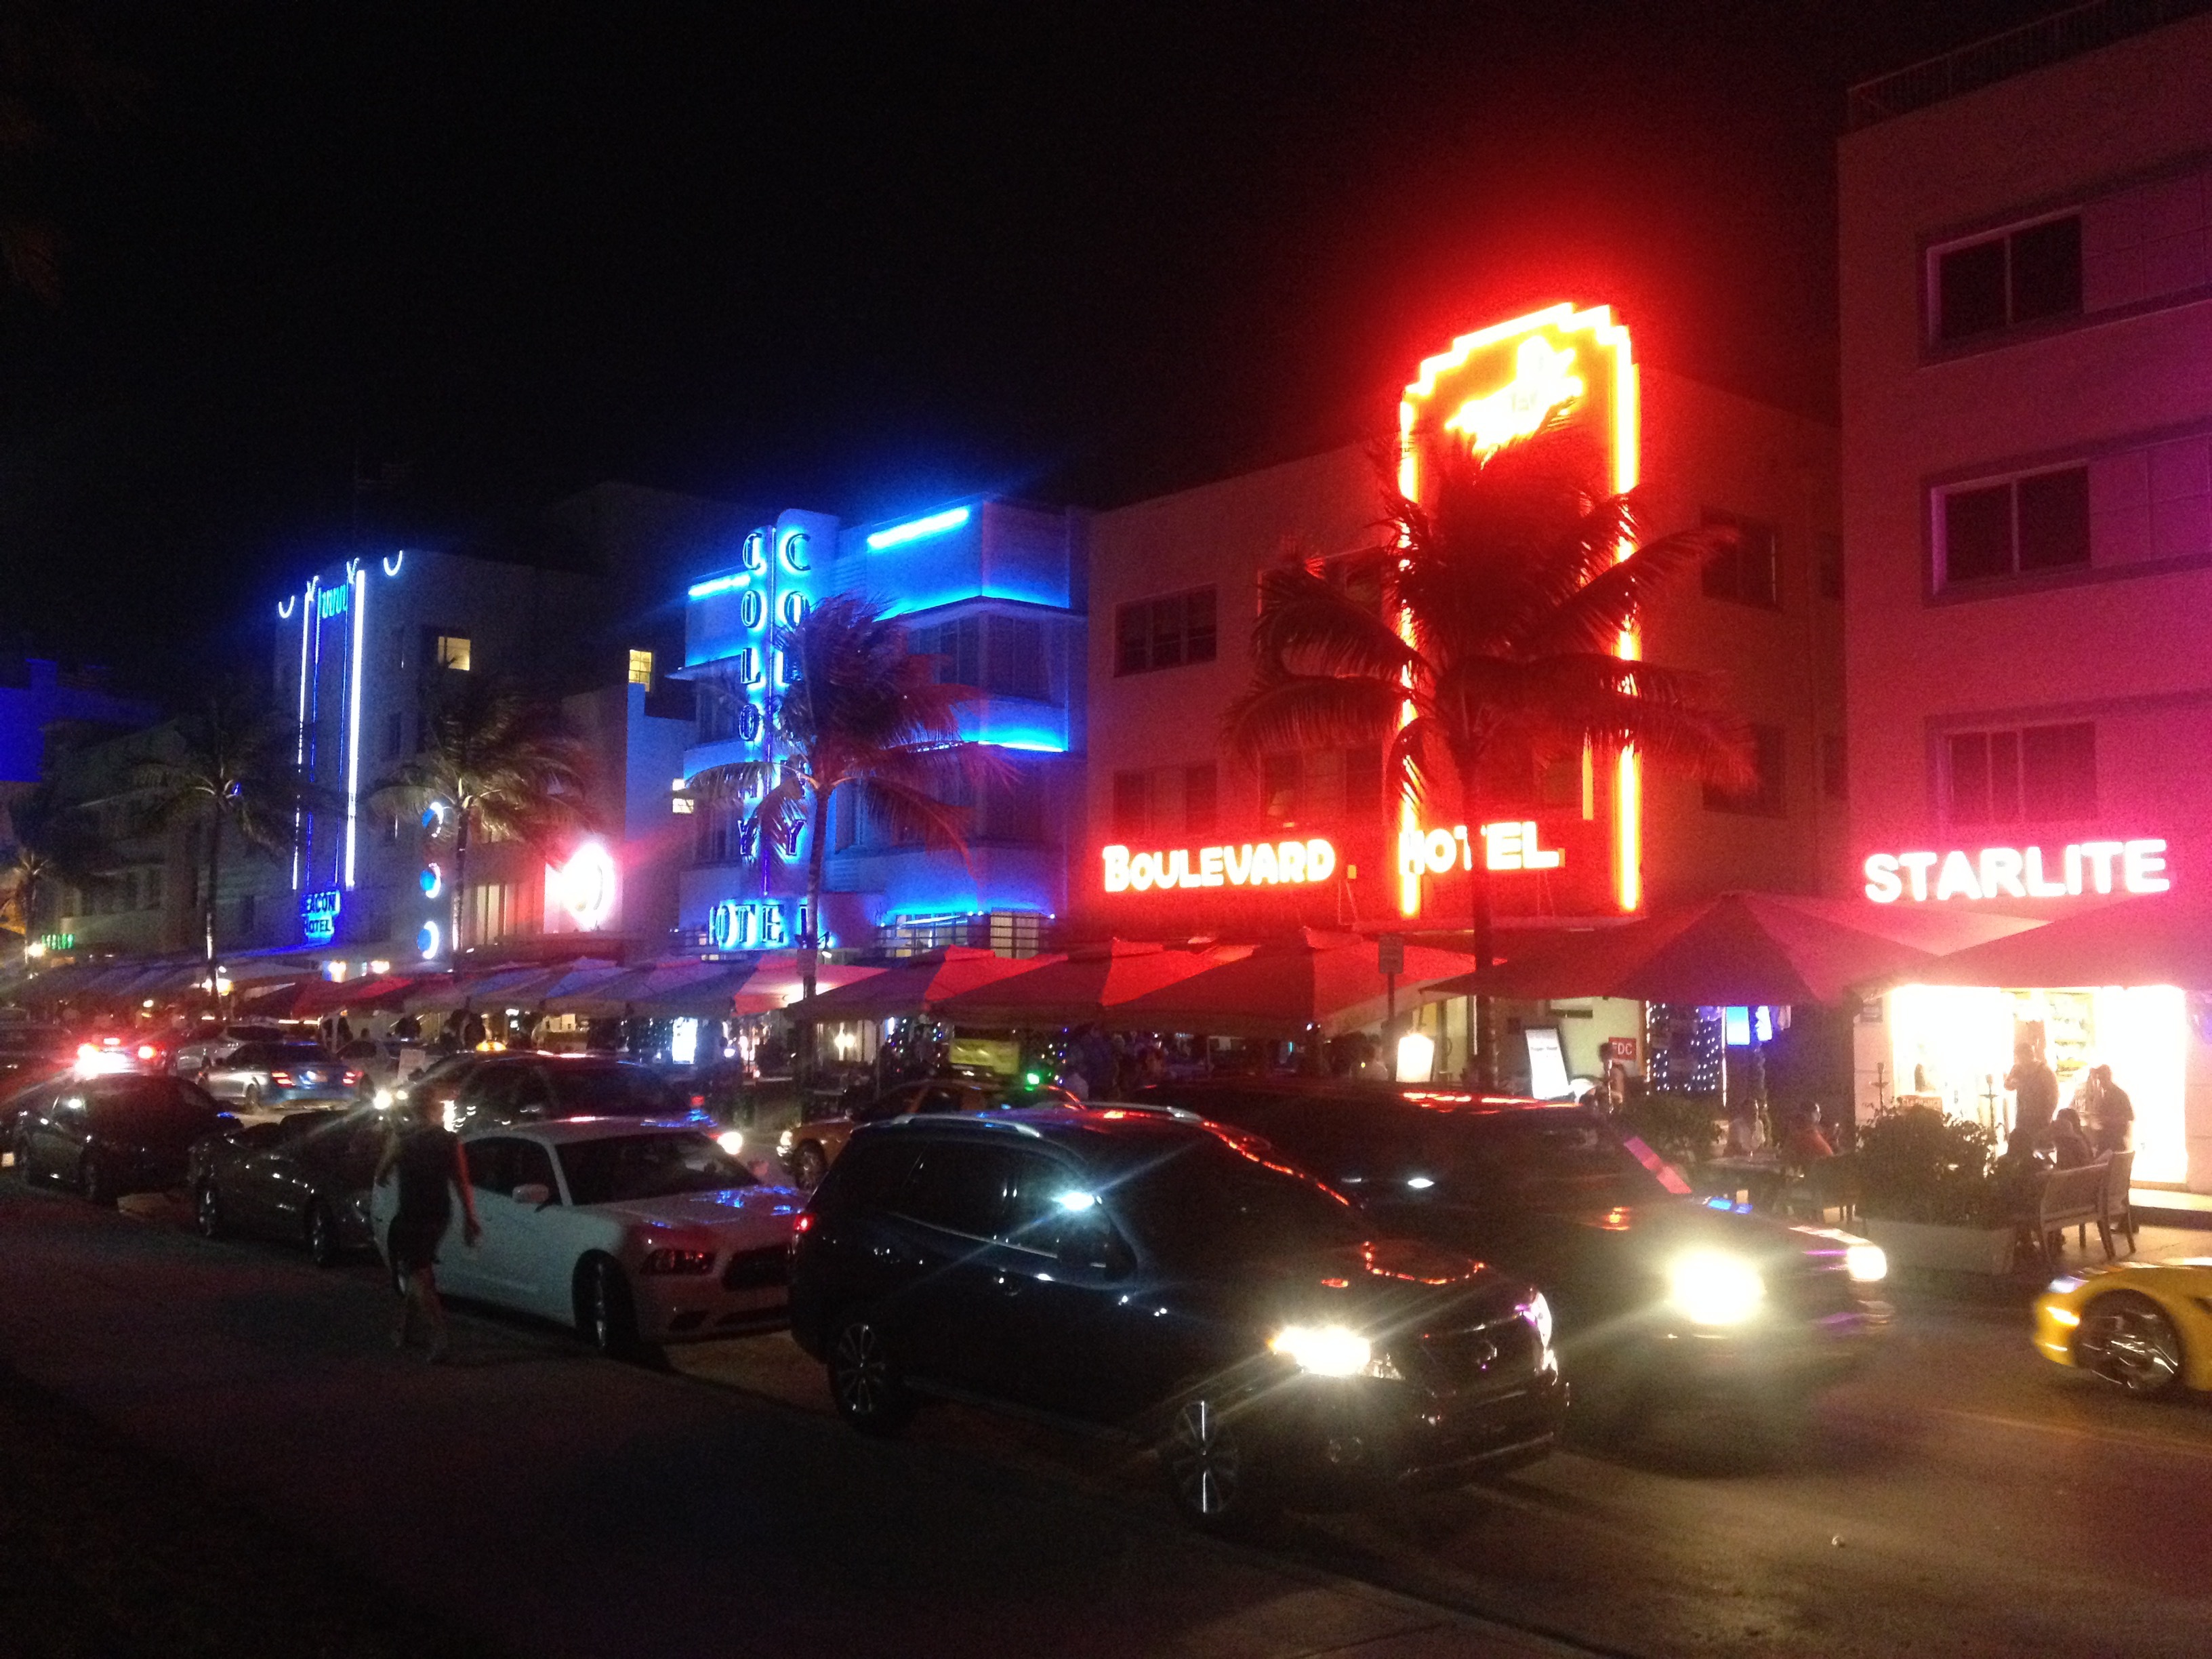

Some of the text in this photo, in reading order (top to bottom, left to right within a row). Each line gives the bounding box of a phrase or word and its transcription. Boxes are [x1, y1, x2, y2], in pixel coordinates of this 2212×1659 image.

[1103, 838, 1336, 893] BOULEVARD
[1864, 839, 2170, 903] STARLITE
[302, 893, 337, 914] EACON
